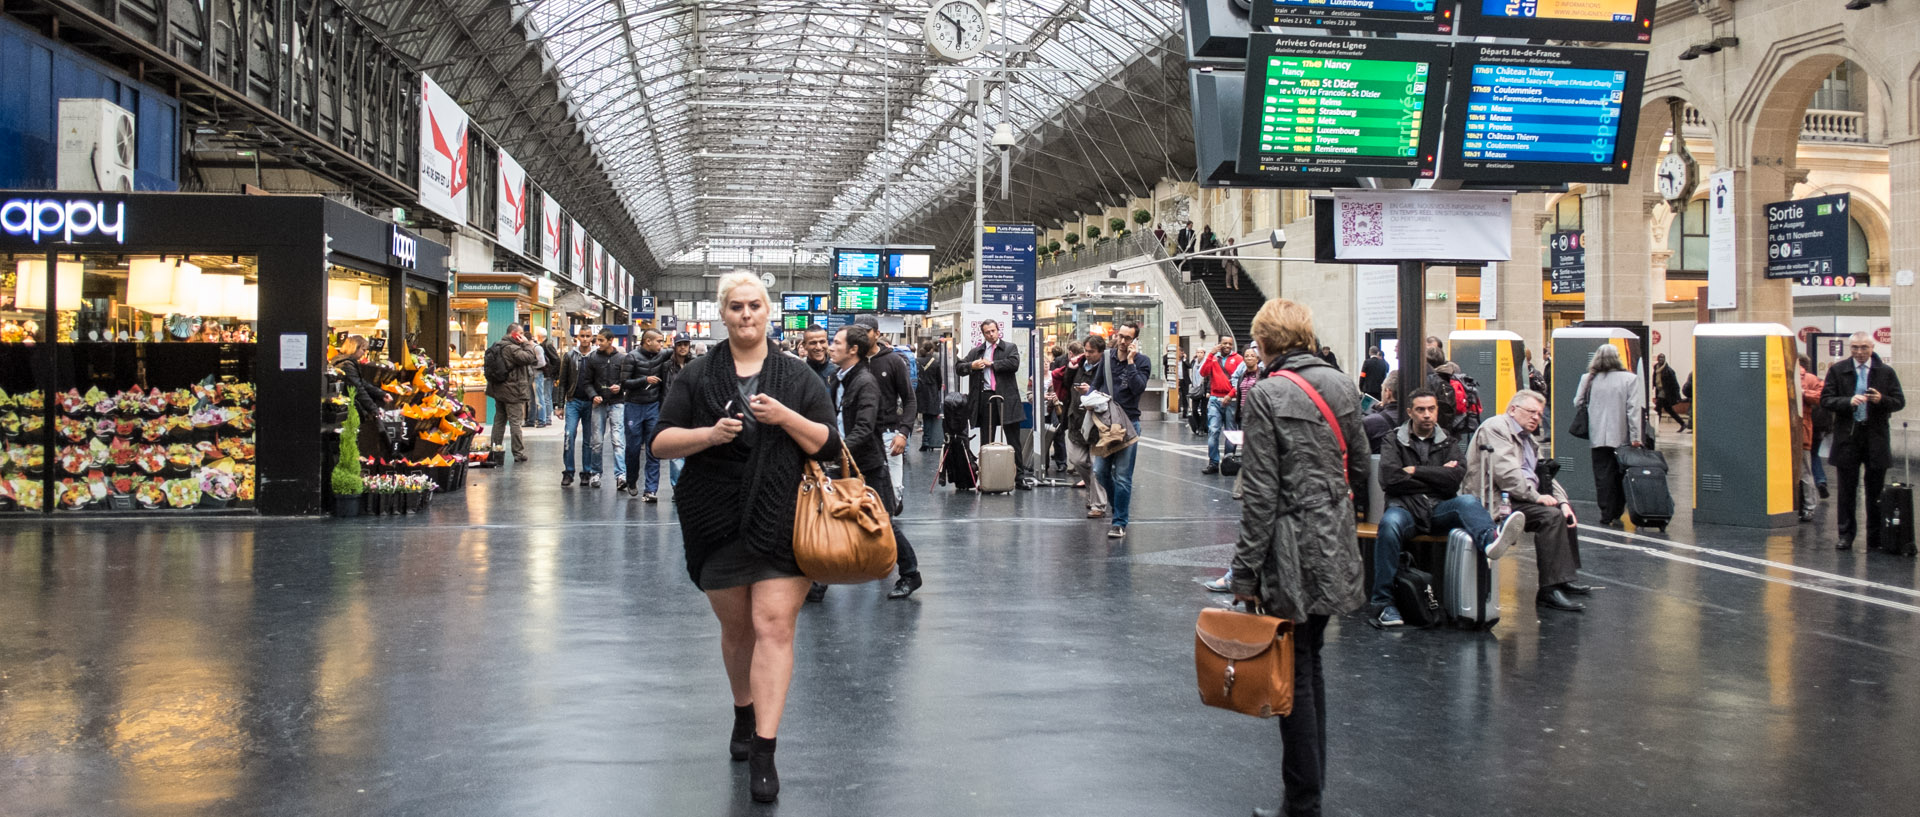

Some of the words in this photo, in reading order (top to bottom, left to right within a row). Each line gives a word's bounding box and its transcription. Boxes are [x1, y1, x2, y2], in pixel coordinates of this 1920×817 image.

[1276, 39, 1308, 47] Arrivées
[1309, 40, 1340, 49] Grandes
[1342, 41, 1367, 50] Lignes
[1480, 48, 1509, 56] Départs
[1511, 49, 1560, 58] Ile-de-France
[1324, 60, 1352, 71] Nancy
[1282, 68, 1305, 77] Nancy
[1496, 67, 1527, 76] Château
[1528, 68, 1554, 78] Thierry
[1322, 79, 1333, 88] St
[1334, 80, 1359, 88] Dizier
[1547, 78, 1567, 86] Nogent
[1291, 88, 1308, 96] Vitry
[1493, 86, 1542, 94] Coulommiers
[1320, 98, 1342, 106] Reims
[1319, 107, 1357, 118] Strasbourg
[1317, 117, 1336, 125] Metz
[1317, 126, 1360, 136] Luxembourg
[1316, 136, 1339, 144] Troyes
[1516, 133, 1539, 142] Thierry
[1314, 145, 1358, 154] Remiremont
[1769, 205, 1803, 221] Sortie
[1793, 230, 1824, 239] Novembre
[393, 224, 416, 269] happy
[1086, 285, 1160, 297] ACCUEIL
